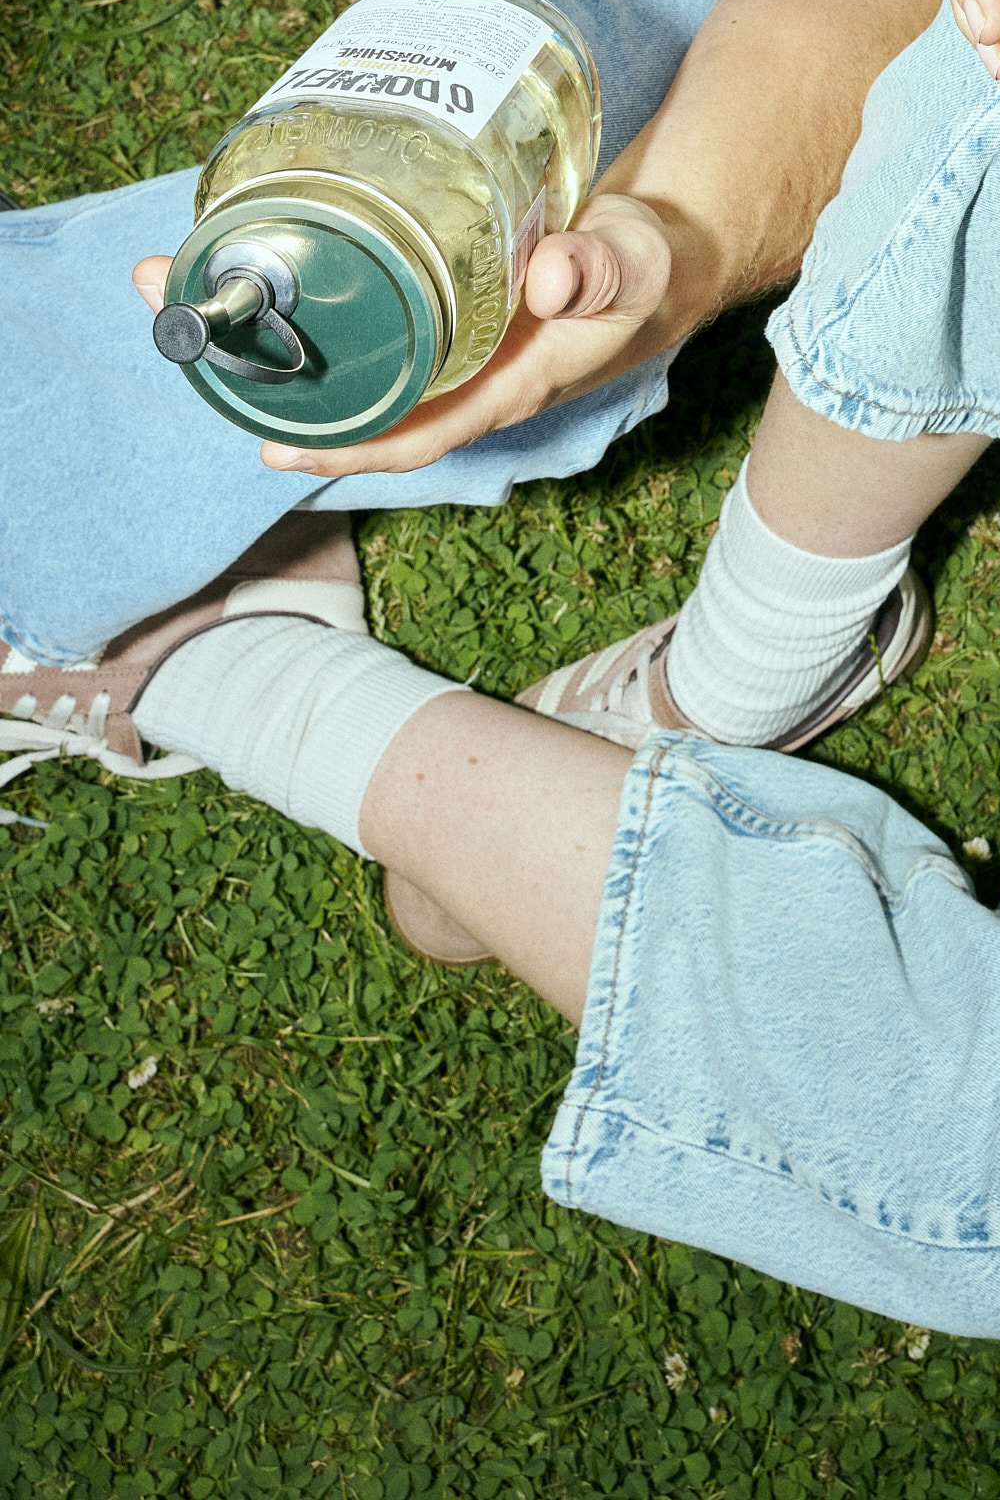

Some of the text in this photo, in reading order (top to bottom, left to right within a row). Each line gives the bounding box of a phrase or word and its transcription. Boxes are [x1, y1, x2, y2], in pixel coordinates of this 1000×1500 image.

[336, 48, 458, 71] MOONSHINE
[449, 48, 472, 59] vol.
[337, 59, 434, 78] HOLUNDER
[473, 57, 506, 79] 20%
[272, 69, 475, 114] O'DONNELL
